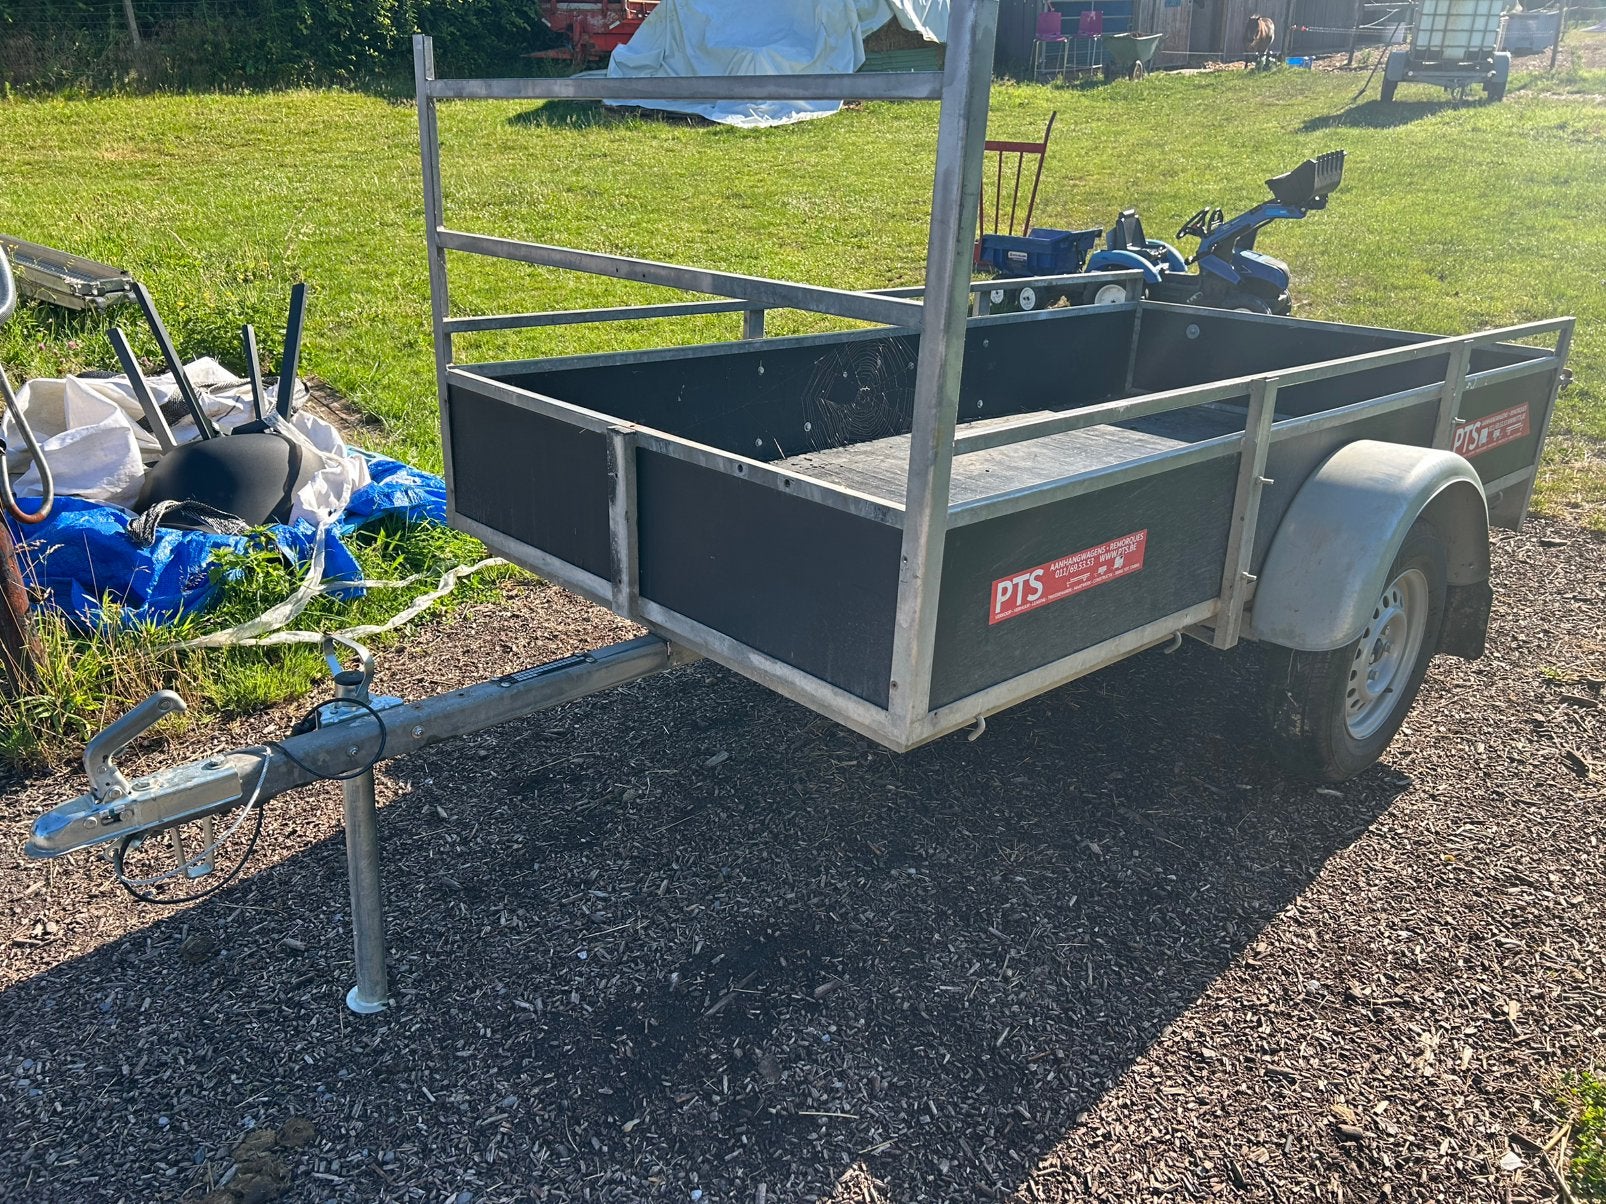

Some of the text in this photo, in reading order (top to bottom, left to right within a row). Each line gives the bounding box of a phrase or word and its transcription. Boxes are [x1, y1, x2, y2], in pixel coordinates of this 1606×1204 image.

[1453, 421, 1482, 453] PTS
[1049, 532, 1144, 571] AANHANGWAGENS REMORQUES
[1055, 558, 1094, 579] 011/69.53.53
[1099, 542, 1137, 563] WWW.PTS.BE
[995, 568, 1045, 614] PTS
